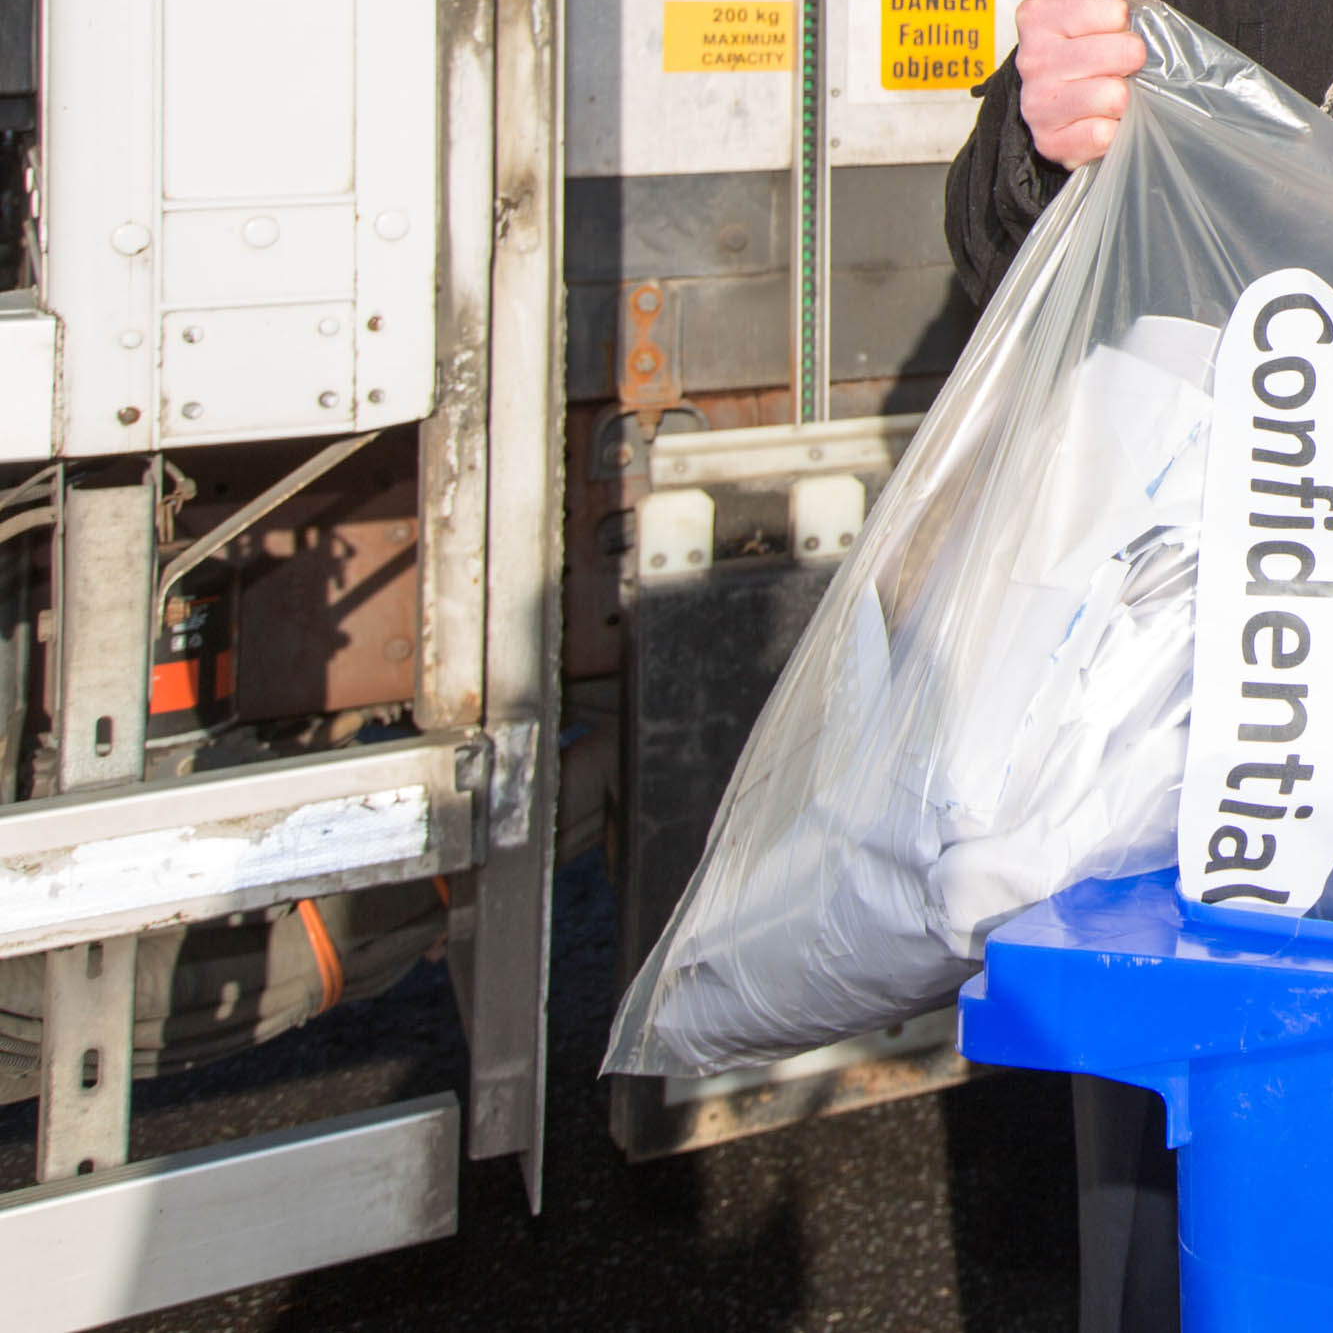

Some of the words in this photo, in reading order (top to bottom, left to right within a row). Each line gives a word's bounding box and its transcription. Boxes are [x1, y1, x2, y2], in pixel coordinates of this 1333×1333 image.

[712, 7, 748, 24] 200
[755, 7, 780, 27] kg
[702, 32, 786, 47] MAXIMUM
[899, 23, 980, 50] Falling
[701, 51, 785, 66] CAPACITY
[893, 56, 985, 80] objects
